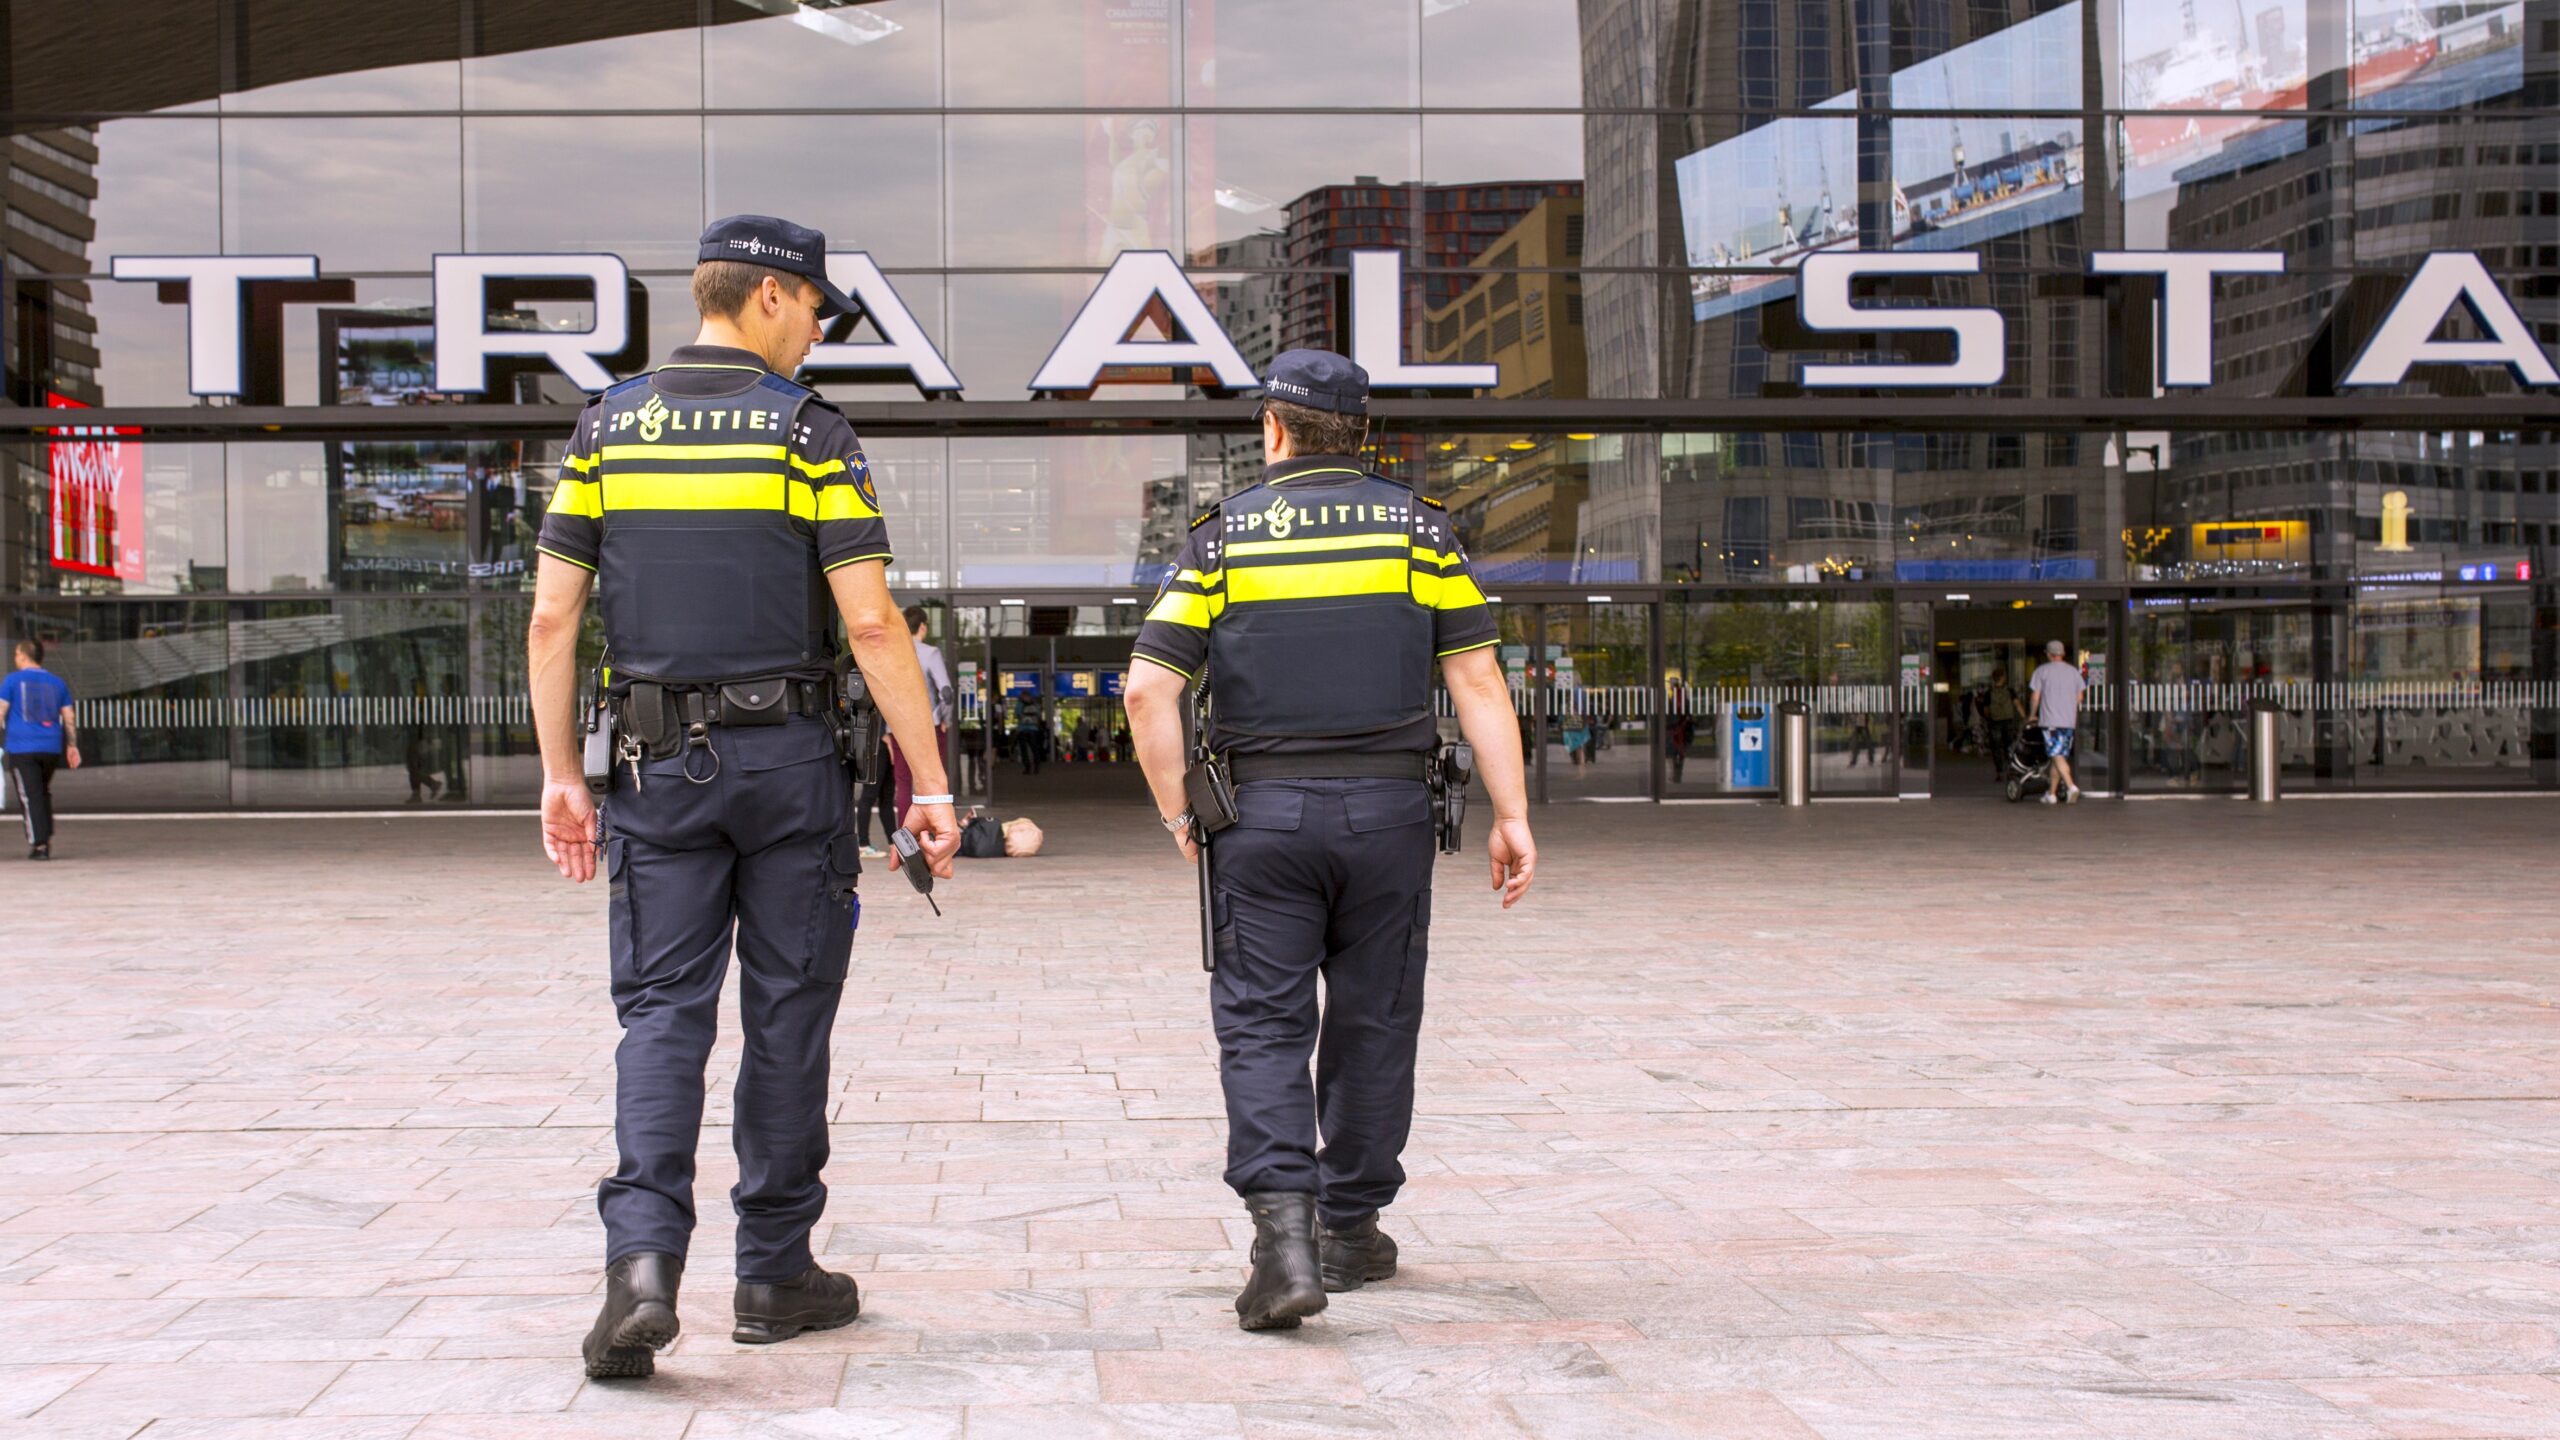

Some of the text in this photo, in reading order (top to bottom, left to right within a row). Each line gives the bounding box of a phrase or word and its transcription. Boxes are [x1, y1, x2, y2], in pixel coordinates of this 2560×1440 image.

[743, 237, 793, 259] POLITIE
[111, 250, 2560, 394] TRAAL STA
[618, 394, 767, 442] POLITIE
[1247, 496, 1388, 539] POLITIE
